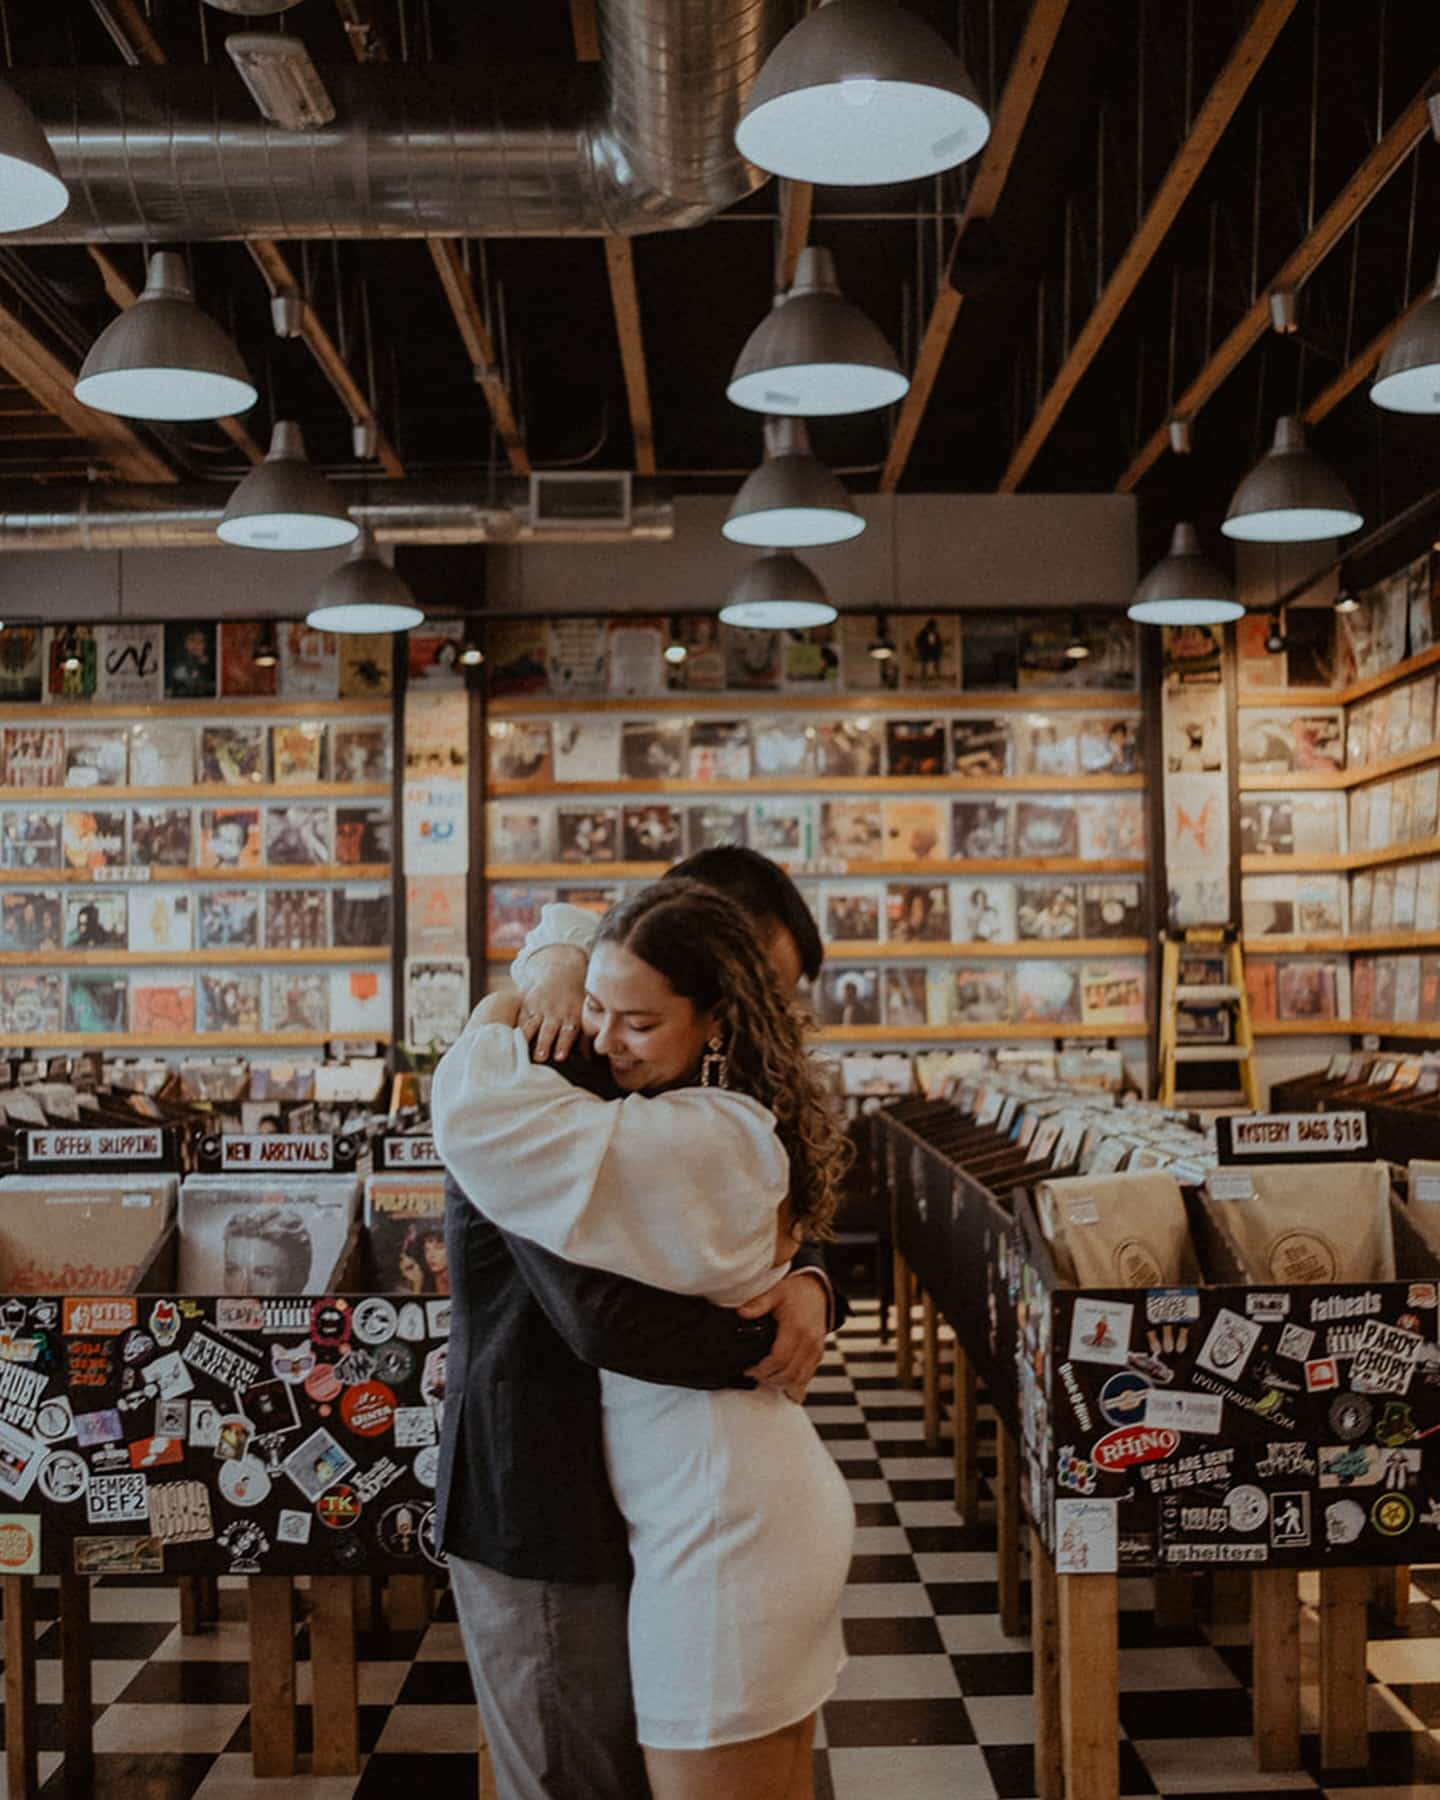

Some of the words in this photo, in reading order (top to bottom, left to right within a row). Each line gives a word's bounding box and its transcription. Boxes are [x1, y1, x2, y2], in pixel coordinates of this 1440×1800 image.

[1236, 1121, 1290, 1144] MYSTERY
[1297, 1119, 1329, 1142] BAGS
[32, 1136, 47, 1156] WE
[54, 1135, 93, 1155] OFFER
[98, 1134, 158, 1154] SHIPPING
[225, 1141, 252, 1160] NEW
[260, 1141, 329, 1161] ARRIVALS
[389, 1142, 405, 1161] WE
[1100, 1430, 1176, 1464] RHINO
[90, 1492, 145, 1513] DEF2
[323, 1496, 353, 1511] TK
